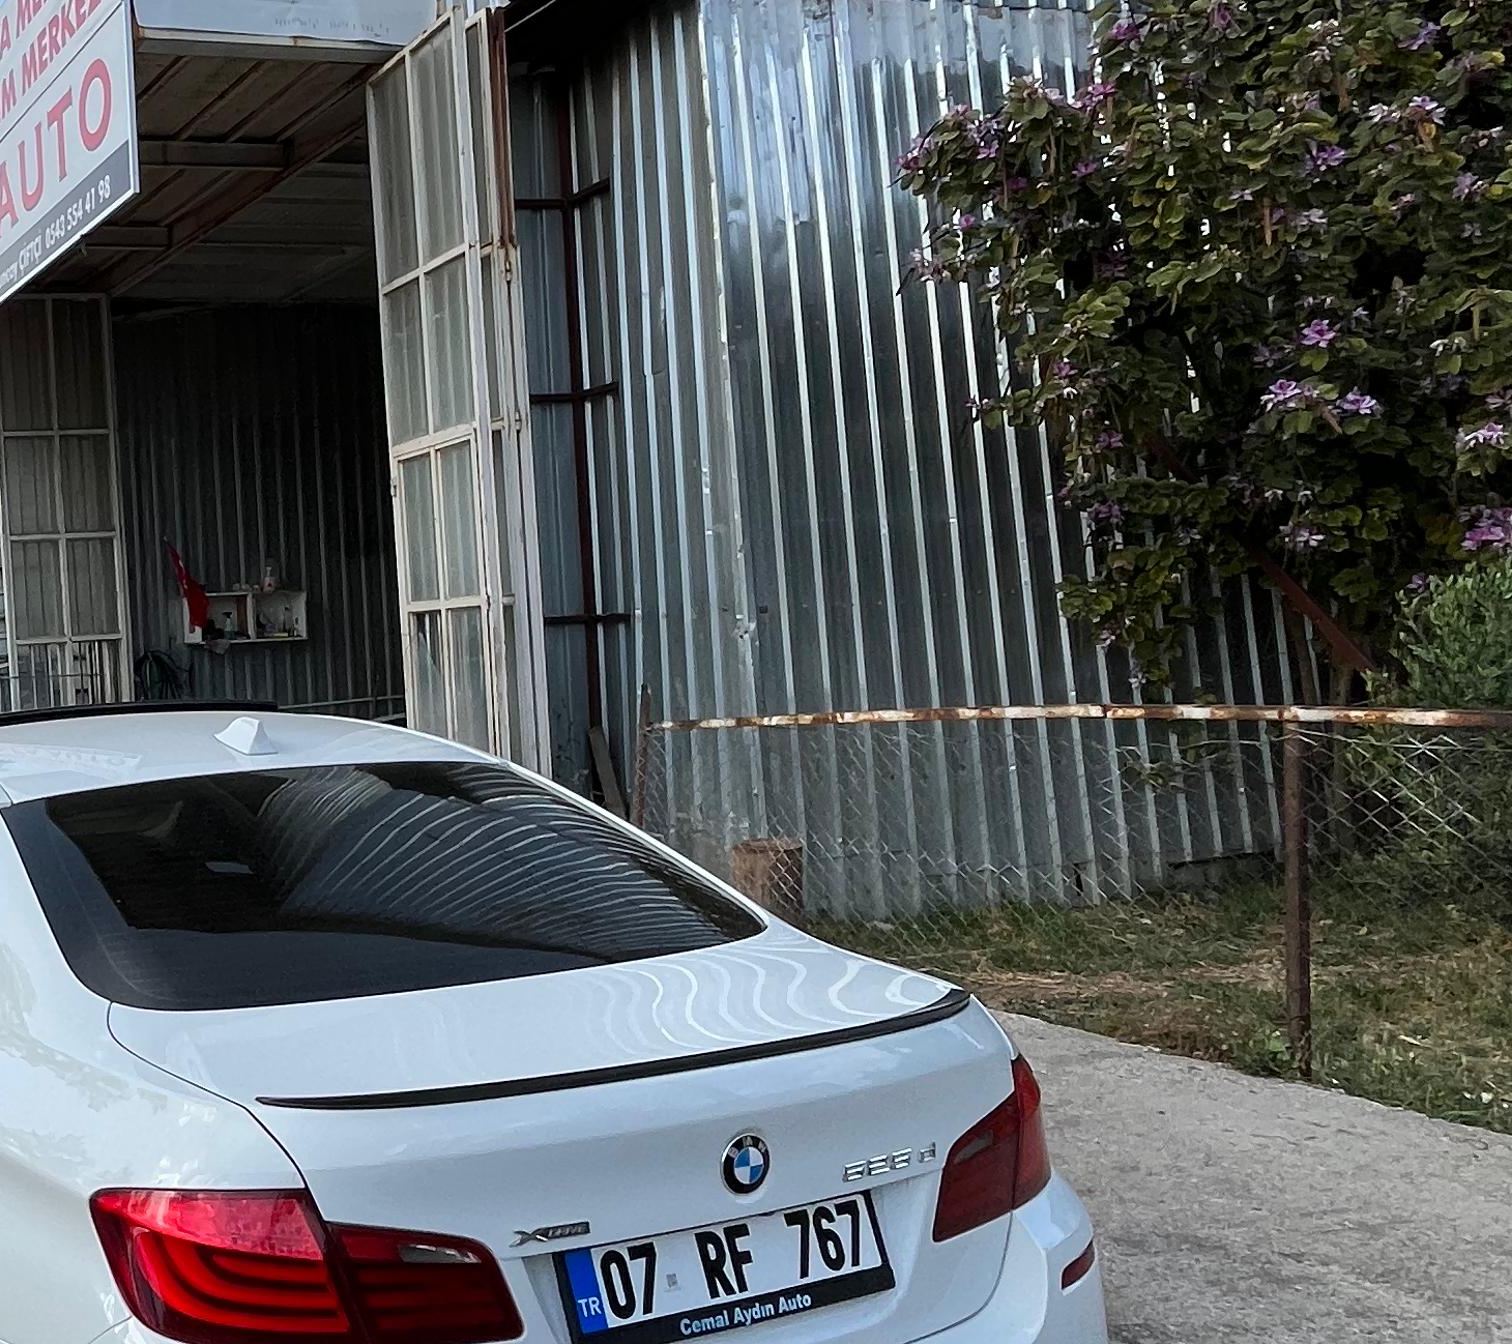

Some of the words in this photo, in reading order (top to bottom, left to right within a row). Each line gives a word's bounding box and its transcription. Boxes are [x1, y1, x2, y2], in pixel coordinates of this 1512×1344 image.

[45, 214, 65, 249] 0543
[67, 198, 83, 231] 554
[85, 187, 95, 214] 41
[98, 174, 110, 203] 98
[600, 1241, 657, 1320] 07
[694, 1223, 753, 1299] RF
[783, 1199, 860, 1280] 767
[578, 1296, 603, 1318] TR
[680, 1310, 730, 1336] Cemal
[778, 1292, 812, 1315] Auto
